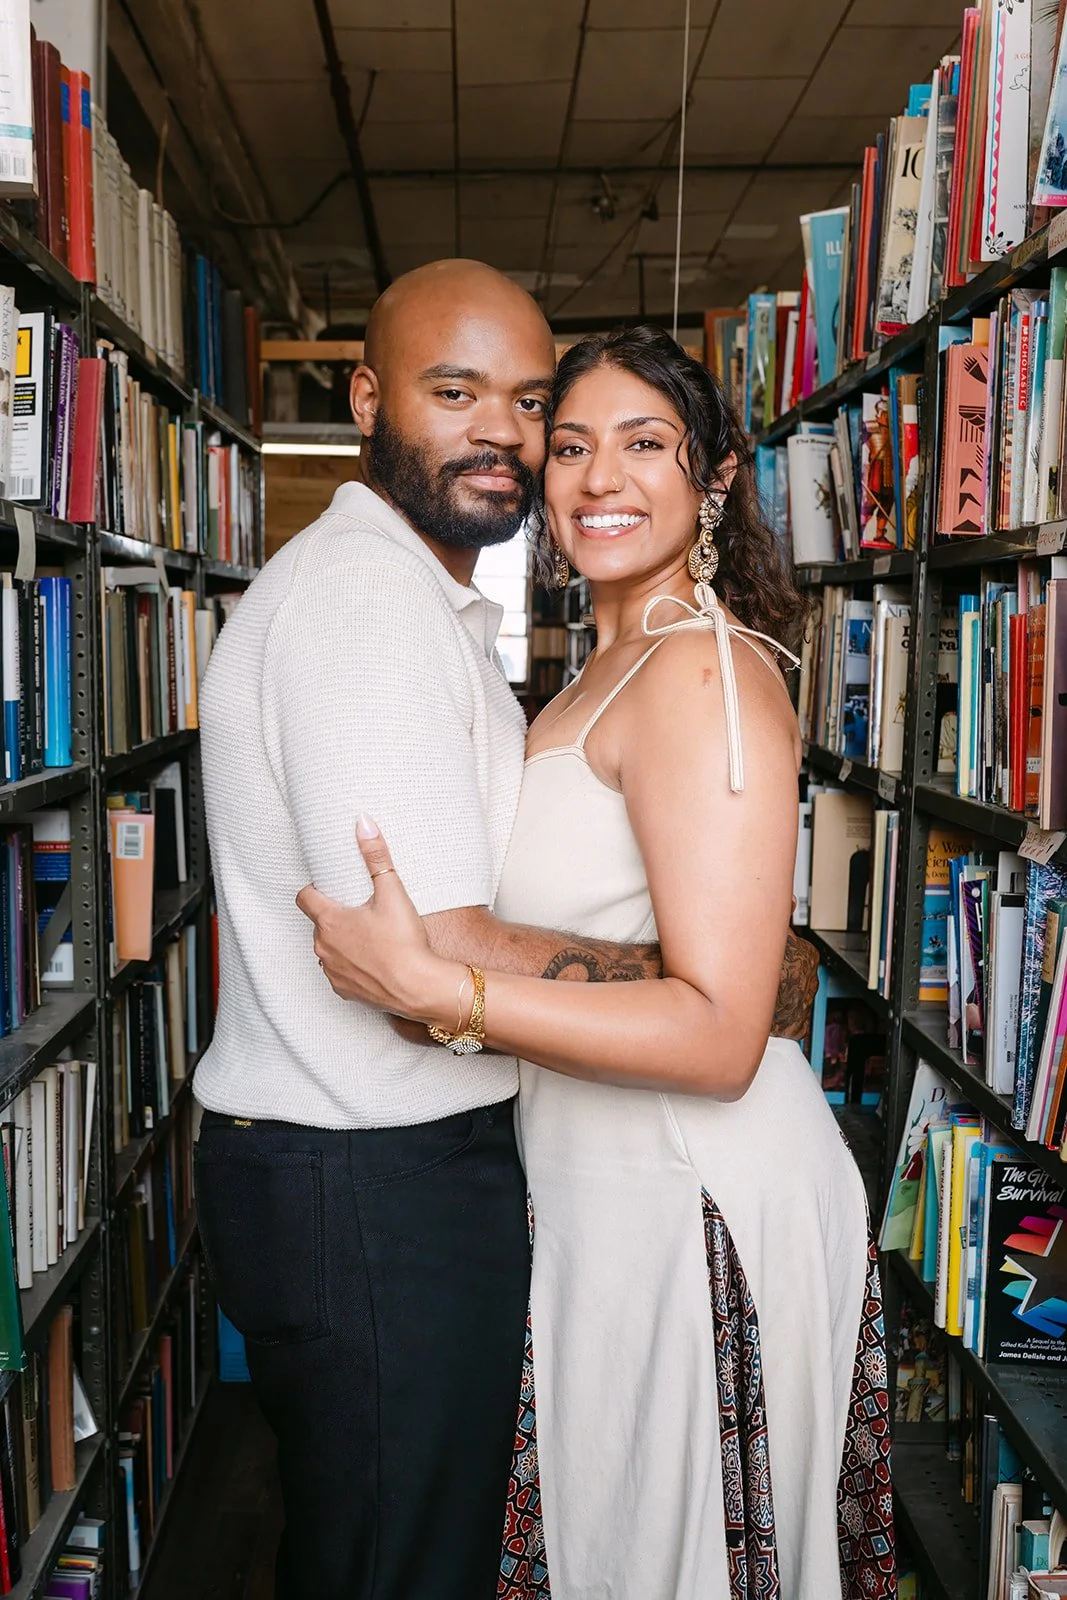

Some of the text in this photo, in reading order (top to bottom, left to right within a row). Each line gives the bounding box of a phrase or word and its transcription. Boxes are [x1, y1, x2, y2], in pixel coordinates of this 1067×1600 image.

[1019, 336, 1029, 407] SCHOLASTIC
[1002, 1167, 1027, 1183] The
[997, 1186, 1065, 1203] Survival
[1022, 1352, 1045, 1361] Delisle
[1046, 1354, 1062, 1362] and
